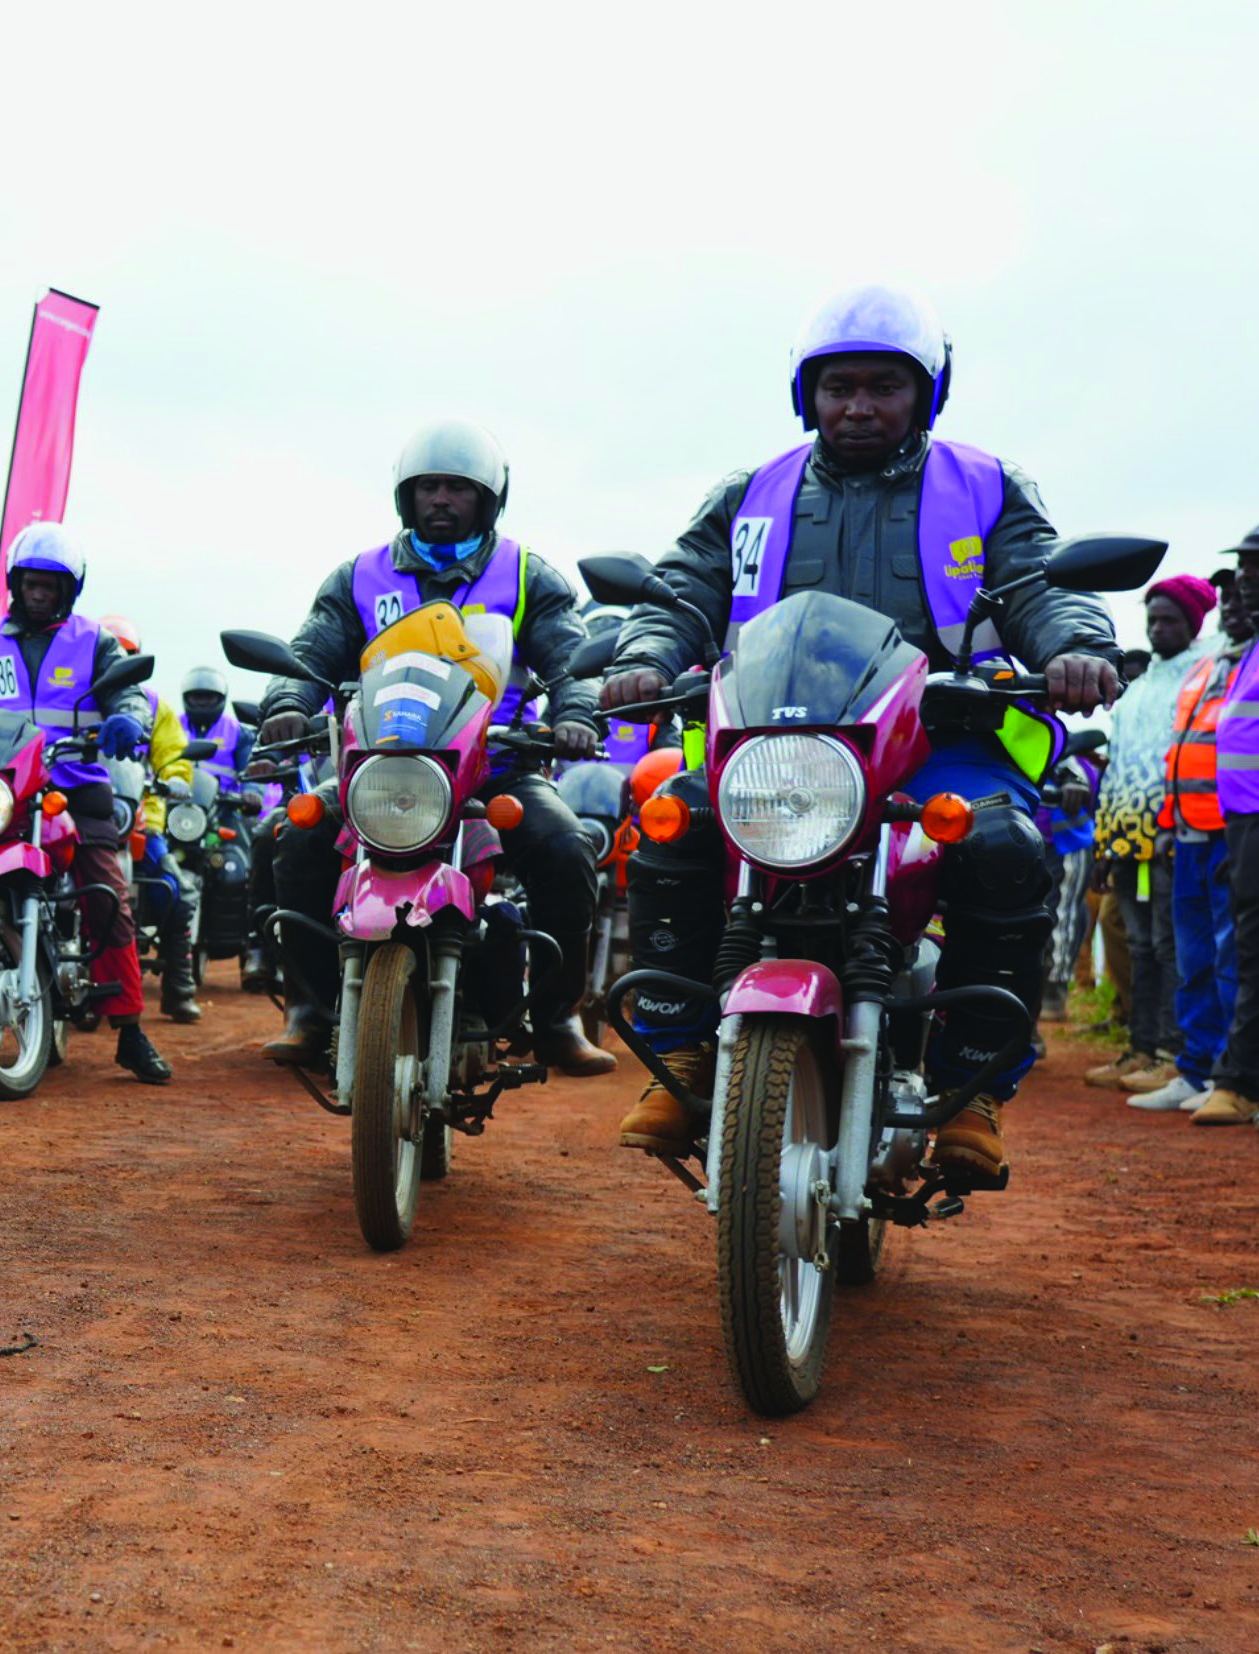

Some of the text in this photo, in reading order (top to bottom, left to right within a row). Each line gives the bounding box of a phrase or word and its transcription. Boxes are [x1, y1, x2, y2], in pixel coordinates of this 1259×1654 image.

[732, 521, 766, 591] 34
[772, 706, 808, 720] TVS
[637, 996, 686, 1015] KWON
